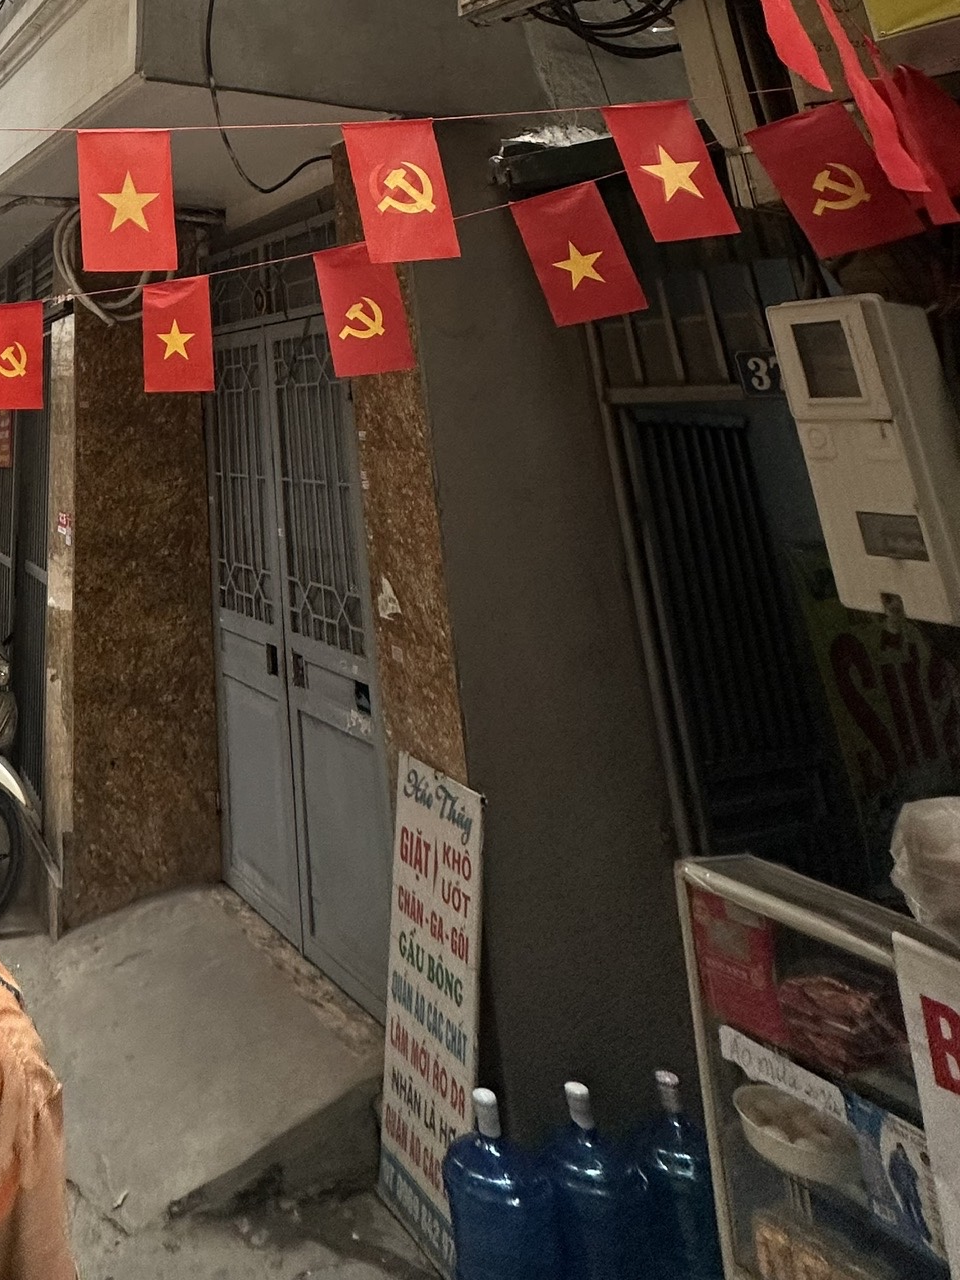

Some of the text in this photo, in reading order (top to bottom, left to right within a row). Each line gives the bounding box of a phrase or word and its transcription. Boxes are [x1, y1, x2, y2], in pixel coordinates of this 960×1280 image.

[400, 825, 472, 881] GIẶT KHÔ
[398, 927, 463, 1008] GẤU BÔNG
[391, 1066, 421, 1119] NHẬN
